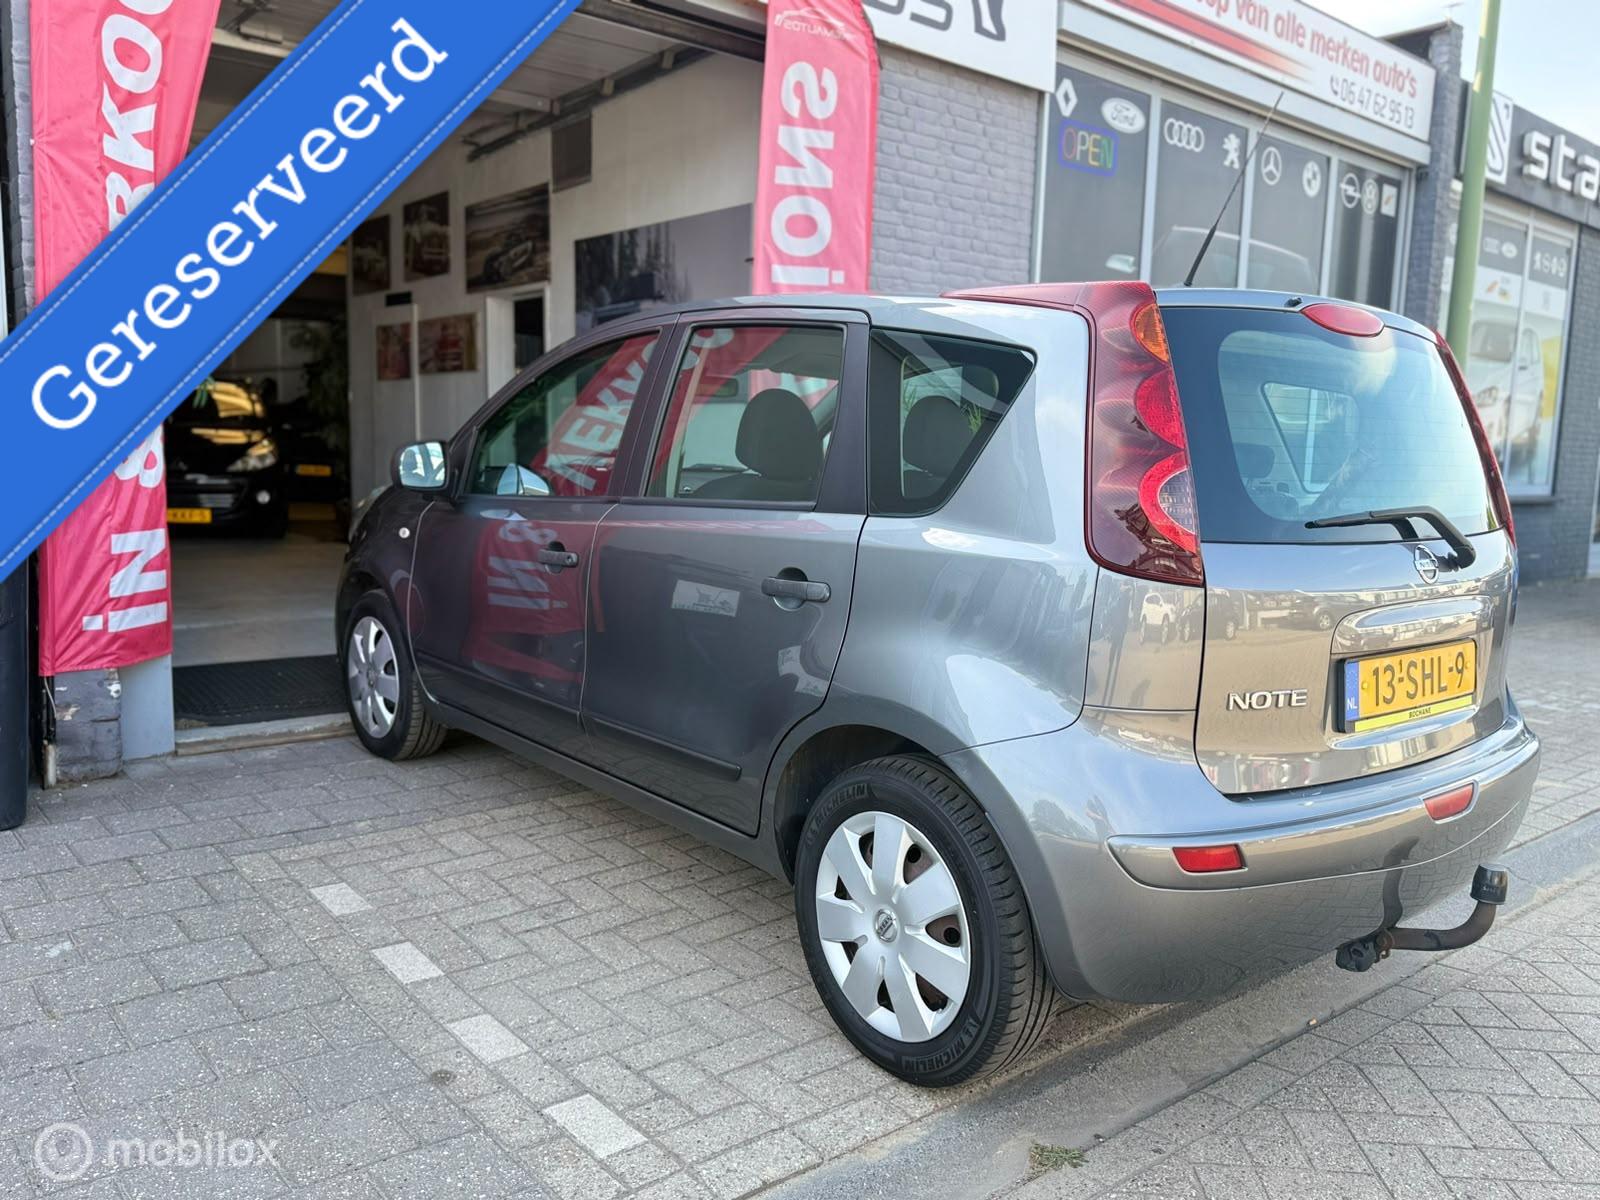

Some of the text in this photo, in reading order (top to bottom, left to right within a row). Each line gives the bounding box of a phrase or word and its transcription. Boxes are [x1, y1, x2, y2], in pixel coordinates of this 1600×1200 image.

[1235, 0, 1269, 33] van
[1274, 11, 1306, 48] alle
[1309, 28, 1369, 78] merken
[1372, 58, 1418, 98] auto's
[101, 0, 173, 231] RKO
[1340, 78, 1414, 129] 06 47 62 95 13
[1063, 127, 1114, 168] OPEN
[1226, 688, 1308, 711] NOTE
[1372, 651, 1465, 707] 13-SHL-9
[1346, 699, 1358, 709] NL
[1408, 707, 1432, 719] BOCHANE
